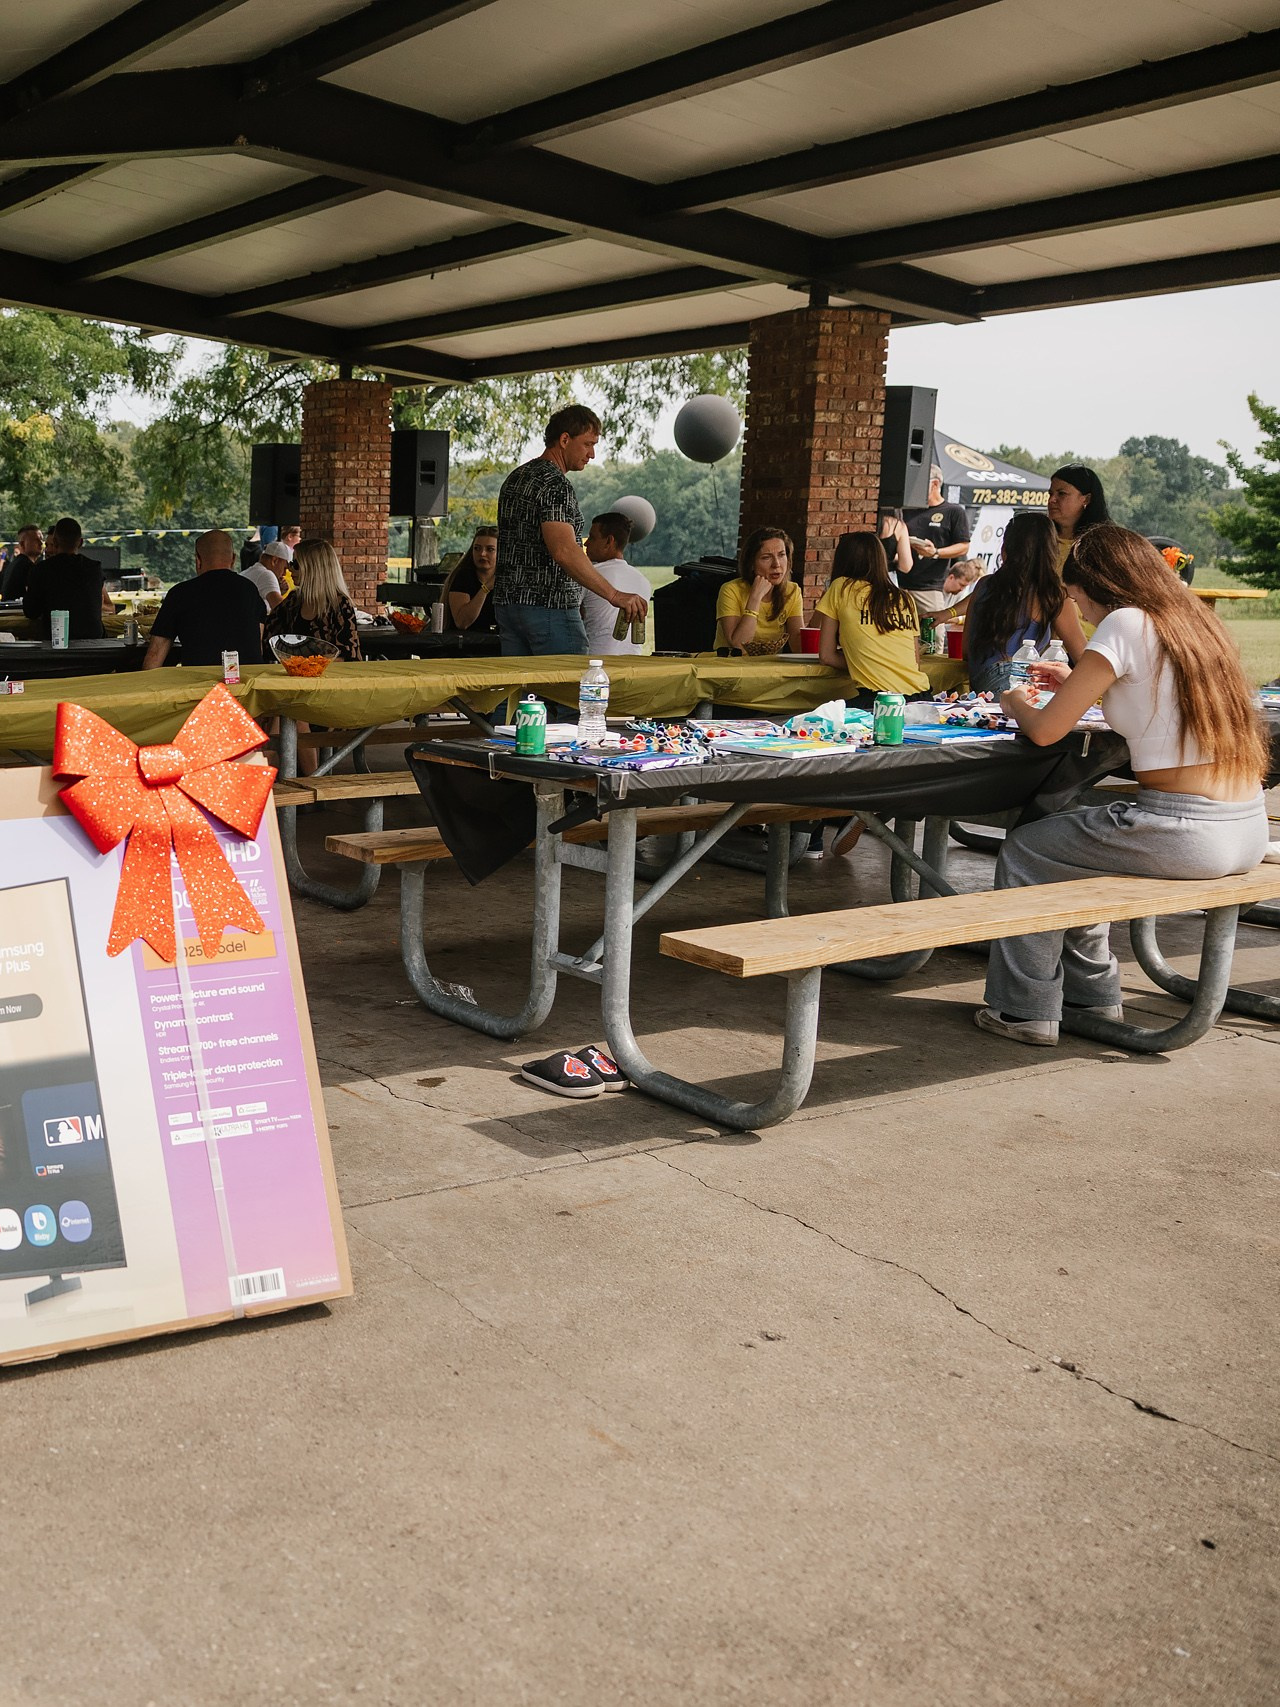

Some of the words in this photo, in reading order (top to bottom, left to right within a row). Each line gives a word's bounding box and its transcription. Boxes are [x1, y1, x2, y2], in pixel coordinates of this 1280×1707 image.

[972, 488, 1051, 505] 773-382-8208
[218, 940, 246, 954] odel
[6, 960, 30, 974] Plus
[186, 988, 217, 1000] icture
[220, 986, 237, 996] and
[238, 982, 265, 994] sound
[6, 1004, 22, 1014] Now
[196, 1012, 234, 1026] contrast
[158, 1044, 192, 1056] Stream
[219, 1038, 238, 1048] free
[239, 1032, 278, 1046] channels
[214, 1064, 236, 1074] data
[238, 1058, 282, 1073] protection
[34, 1232, 50, 1242] Bixby
